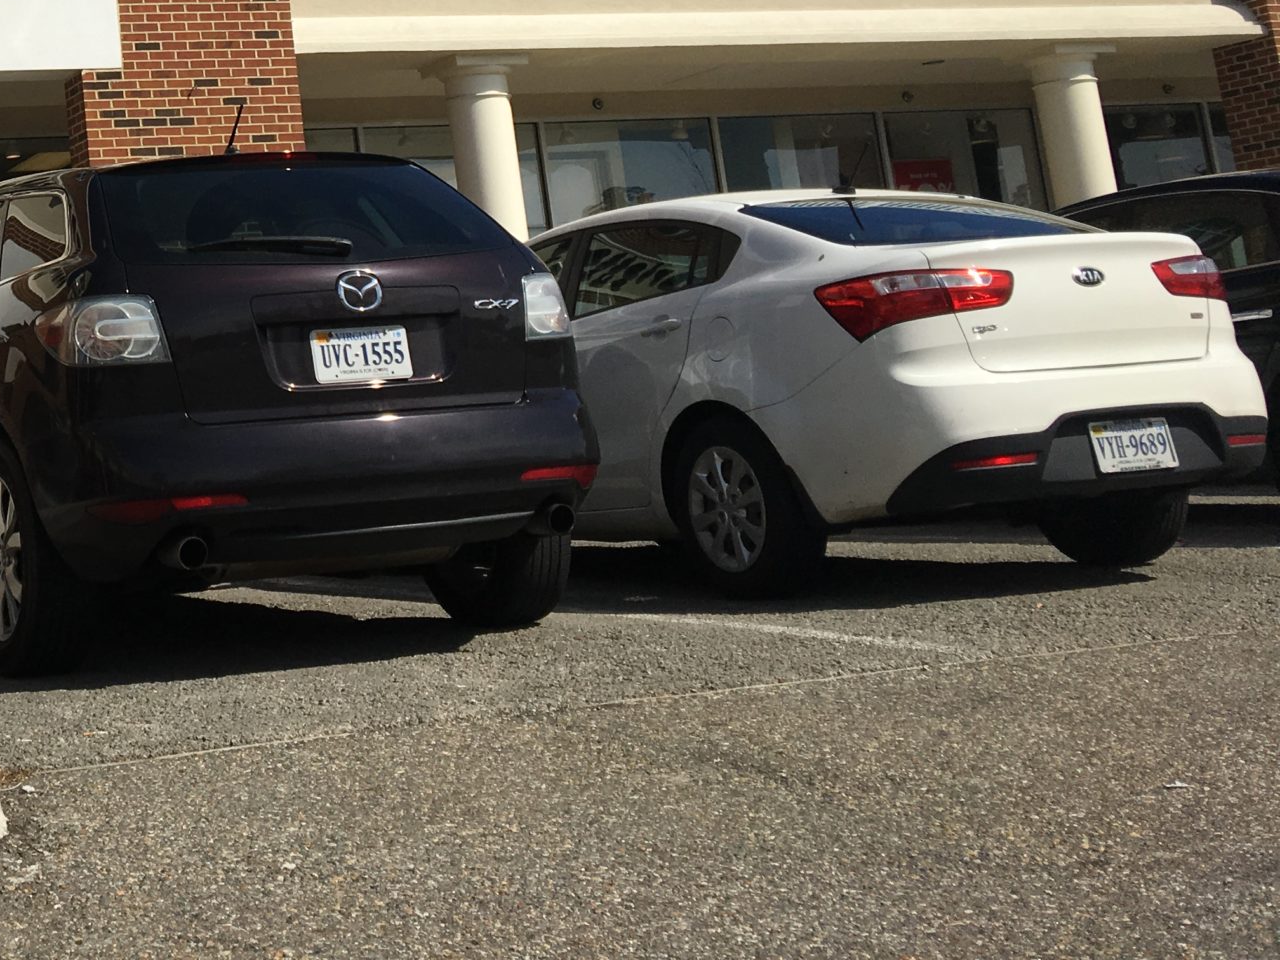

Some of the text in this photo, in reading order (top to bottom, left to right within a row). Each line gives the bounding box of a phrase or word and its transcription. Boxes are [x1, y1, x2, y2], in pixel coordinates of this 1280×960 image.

[474, 298, 519, 310] CX-7
[320, 341, 405, 368] UVC-1555
[1096, 432, 1167, 459] VYH-9689
